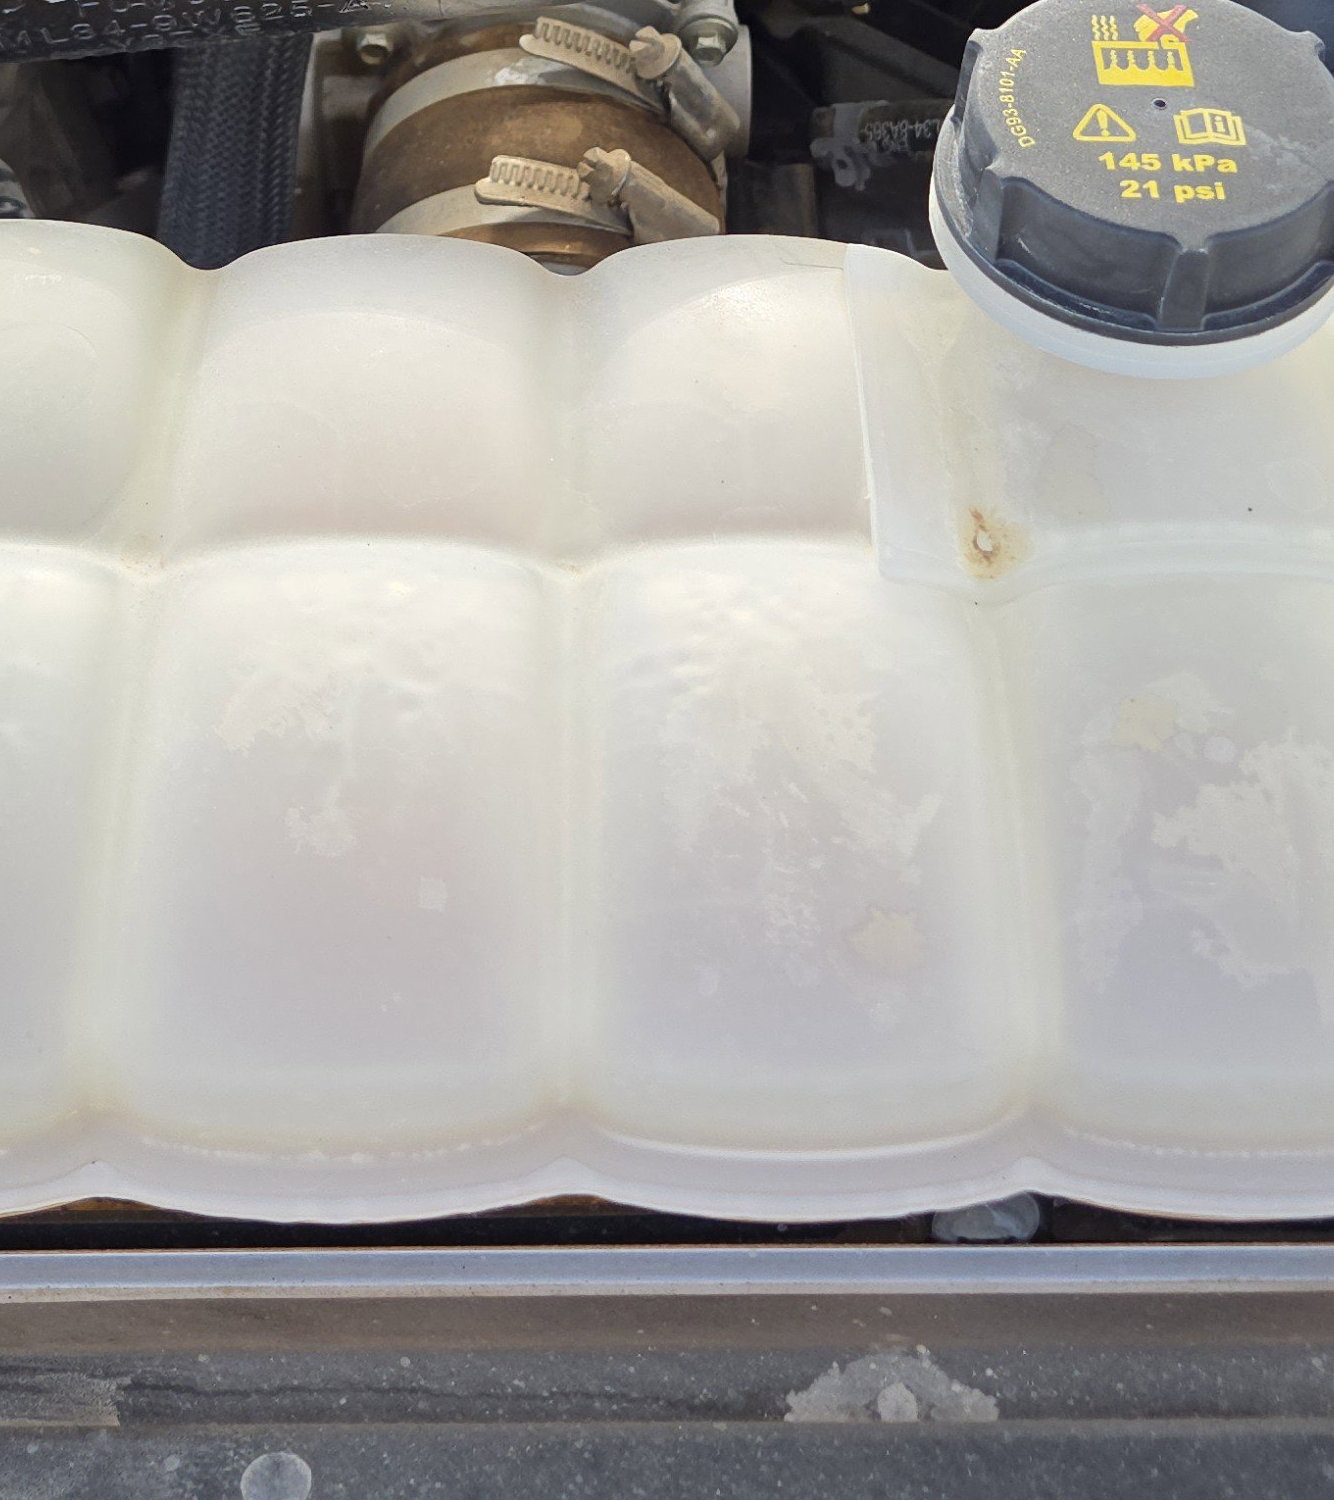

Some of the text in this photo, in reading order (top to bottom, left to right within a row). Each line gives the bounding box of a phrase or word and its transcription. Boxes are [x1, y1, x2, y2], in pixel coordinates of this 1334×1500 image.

[998, 48, 1036, 148] DG93-8101-AA
[1098, 151, 1238, 173] 145 kPa
[1119, 180, 1226, 203] 21 psi
